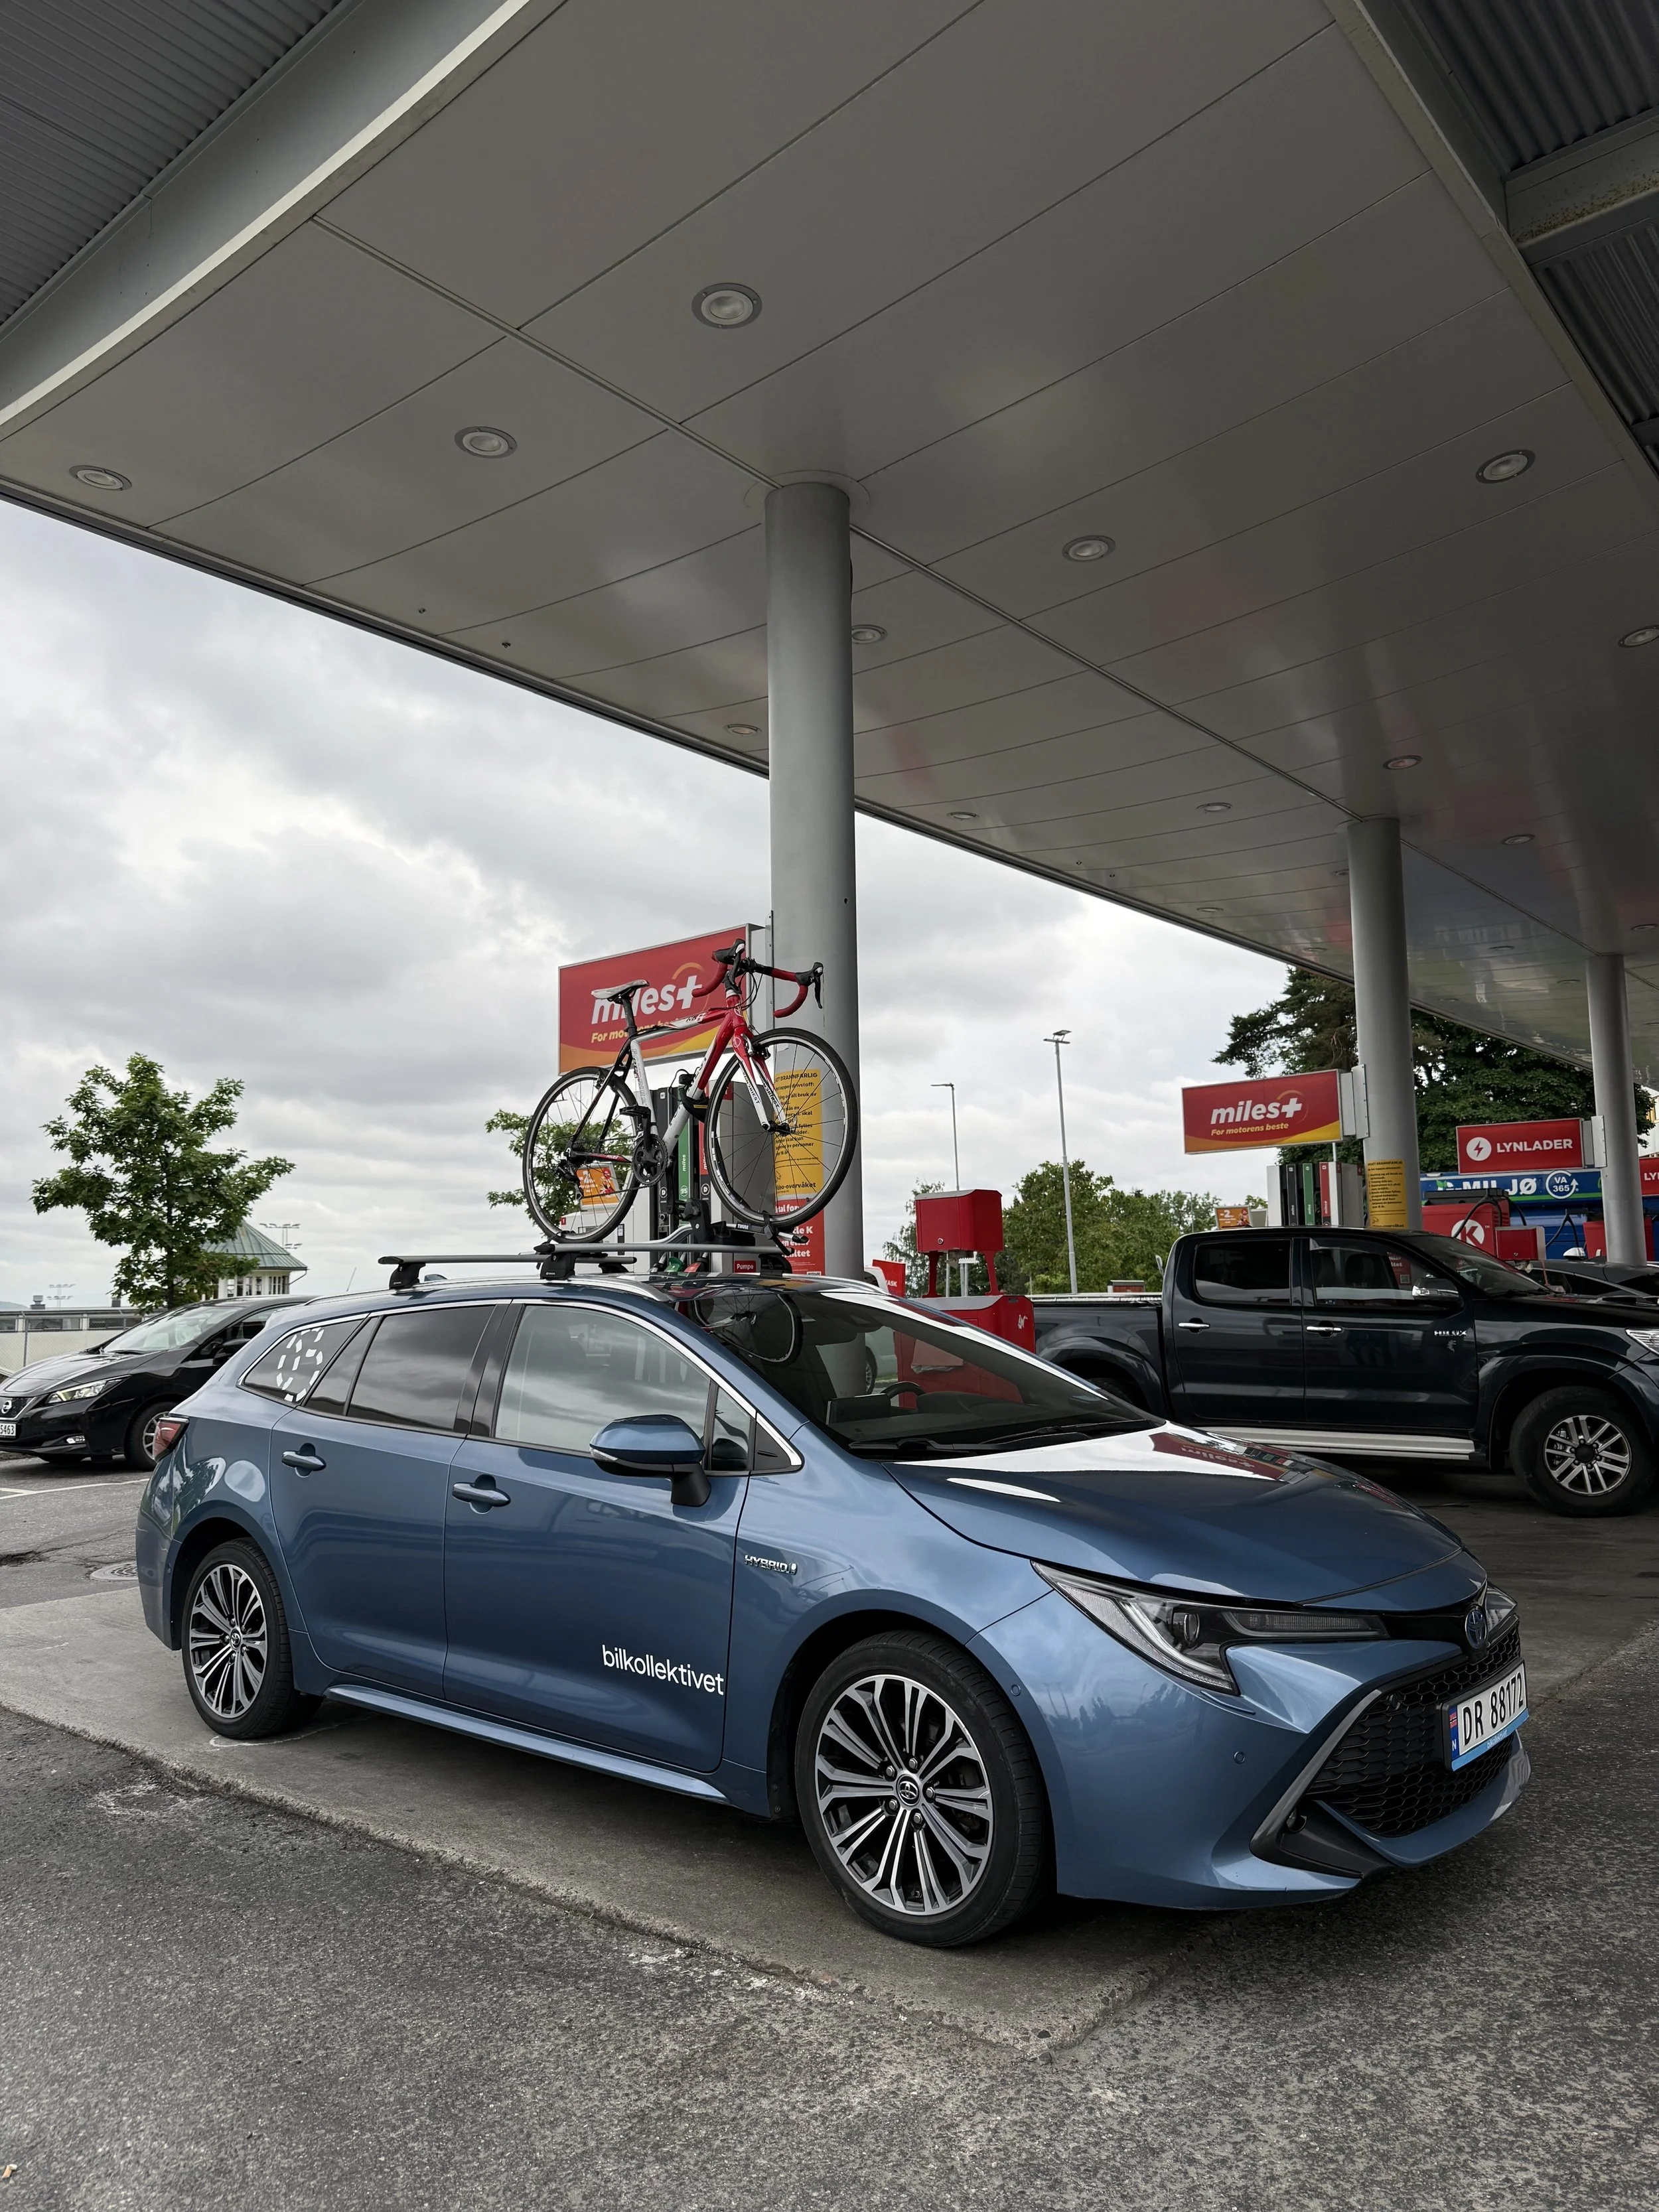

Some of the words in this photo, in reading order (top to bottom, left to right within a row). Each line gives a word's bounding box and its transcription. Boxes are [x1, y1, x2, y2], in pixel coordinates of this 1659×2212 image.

[591, 975, 702, 1024] mles+
[591, 1032, 608, 1043] For
[1226, 1125, 1264, 1135] motorens
[1265, 1122, 1289, 1131] beste
[1496, 1139, 1573, 1152] LYNLADER
[1644, 1172, 1659, 1181] LY
[602, 1644, 724, 1696] bilkollektivet
[1463, 1700, 1484, 1746] DR
[1490, 1671, 1524, 1729] 88172
[1451, 1739, 1457, 1752] N
